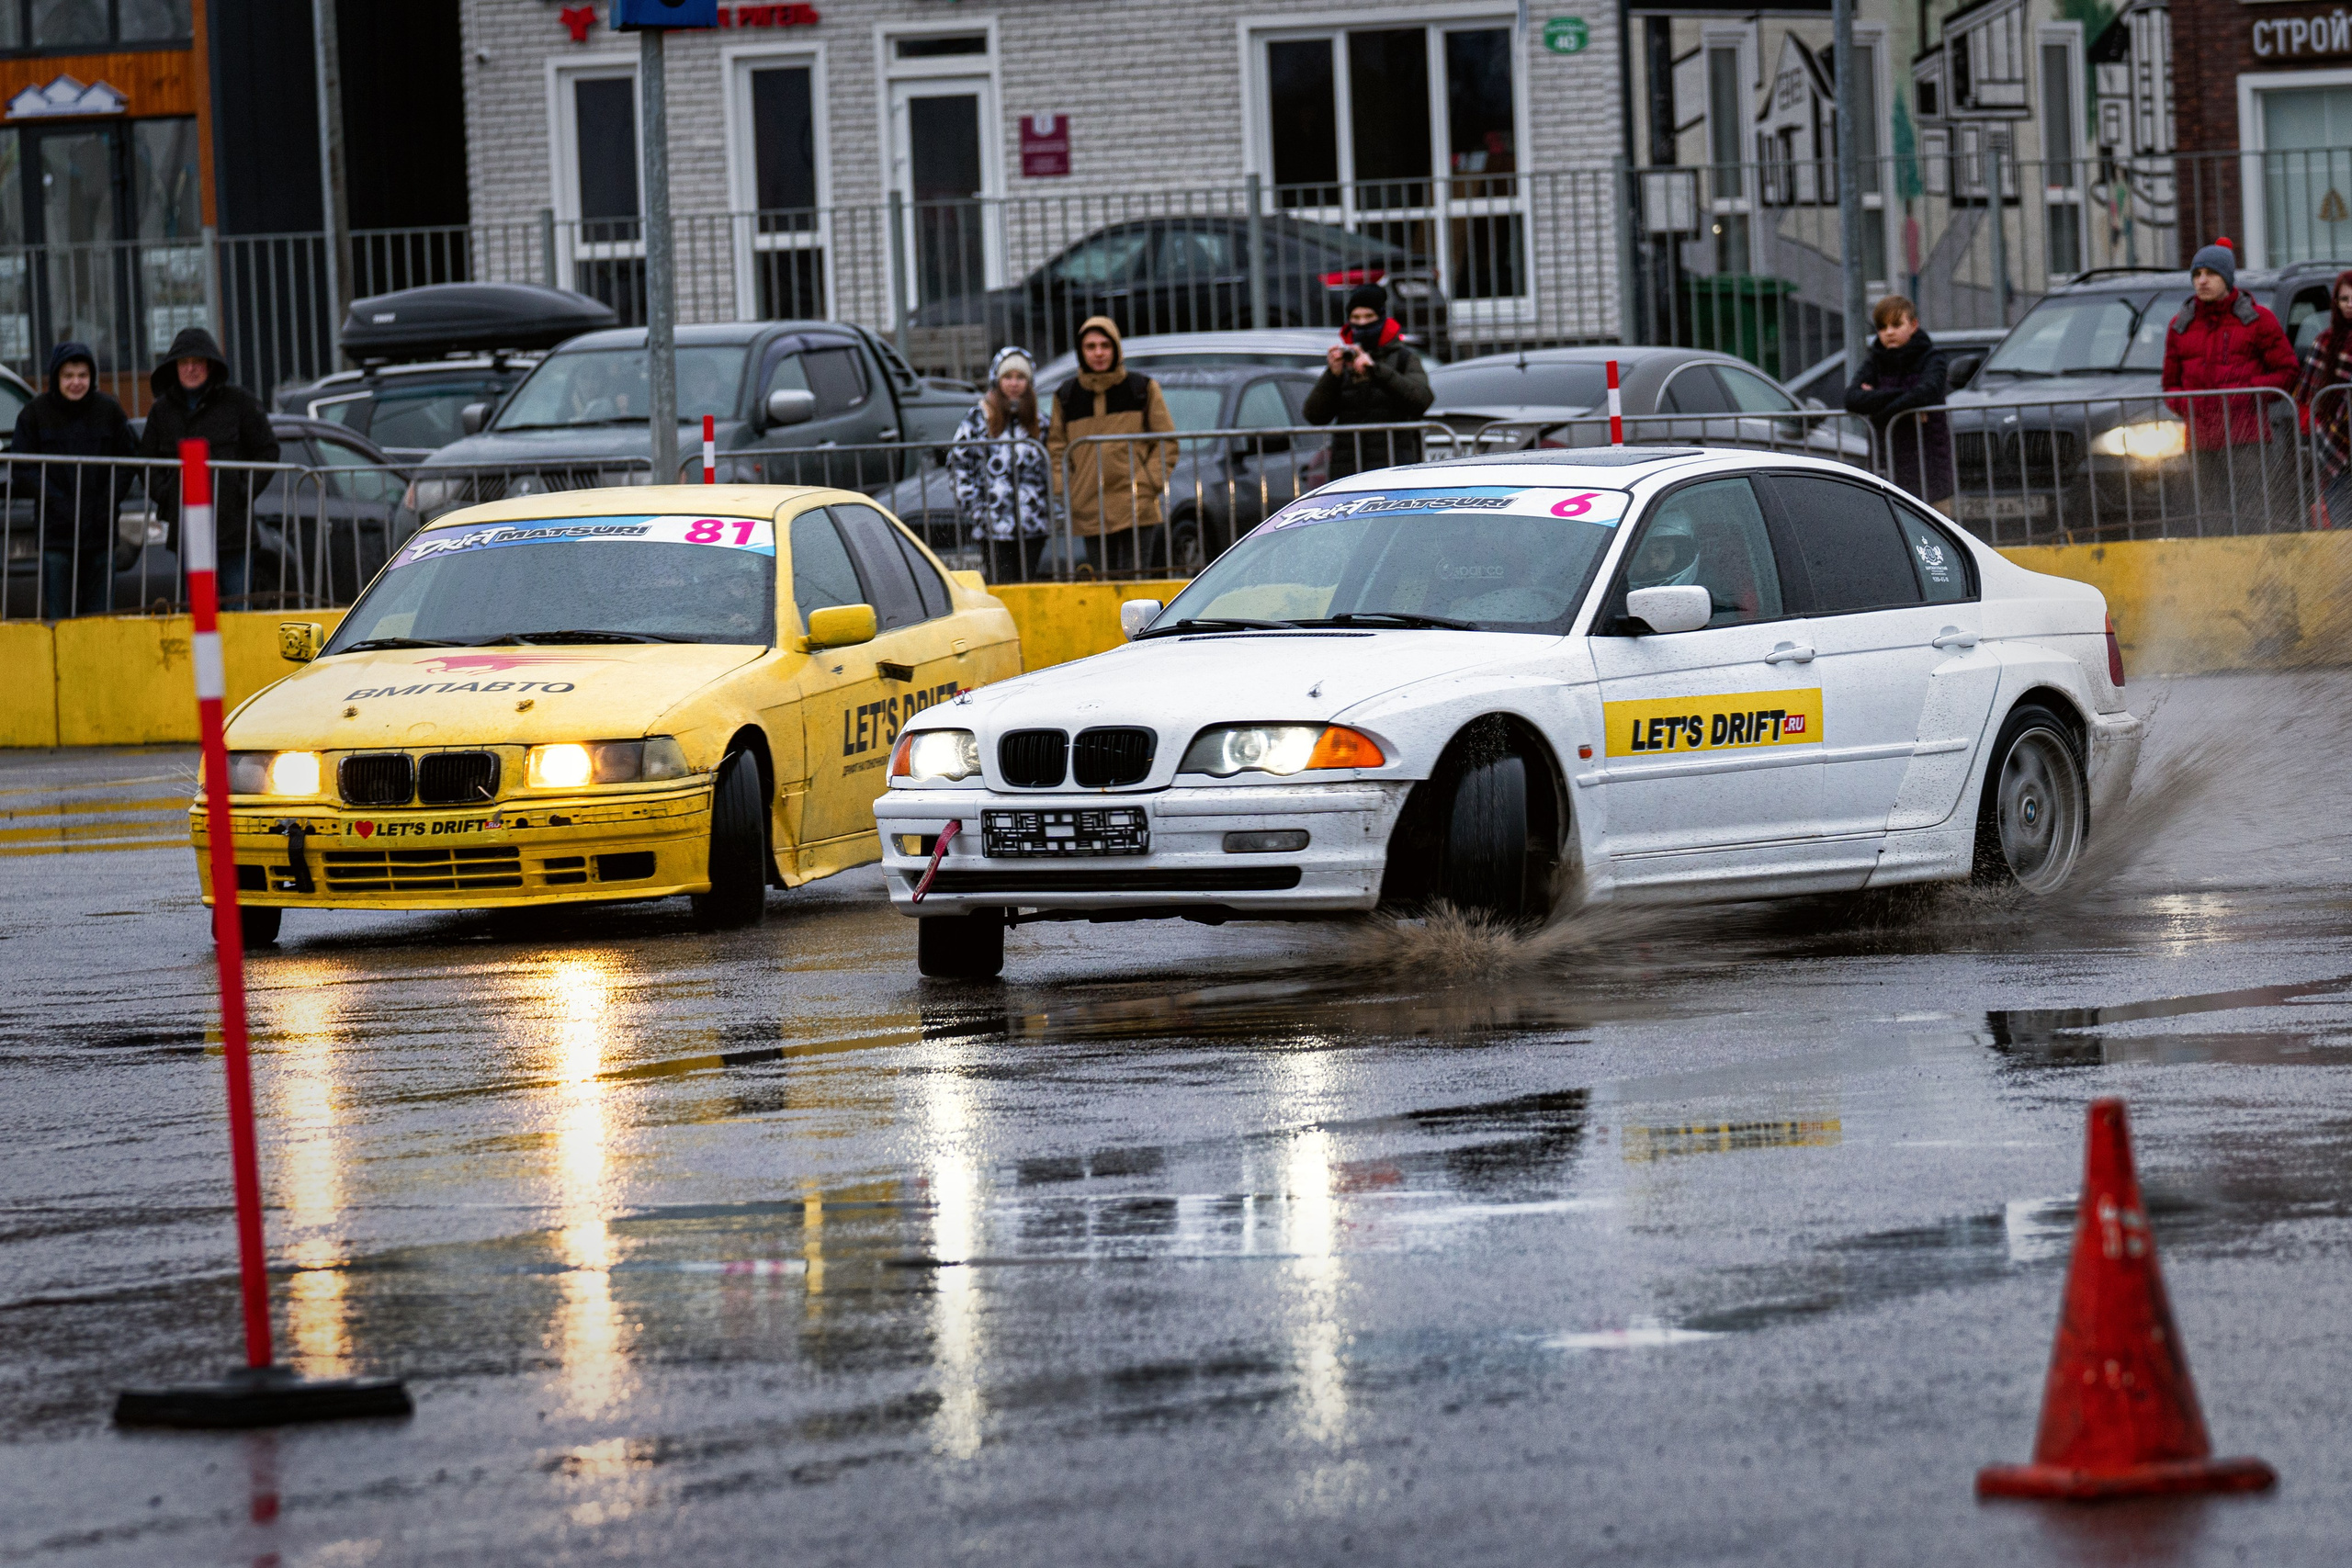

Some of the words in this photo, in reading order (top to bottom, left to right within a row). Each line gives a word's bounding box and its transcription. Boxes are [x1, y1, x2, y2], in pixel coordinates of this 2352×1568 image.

[2253, 7, 2352, 56] СТРОЙ
[1357, 496, 1520, 514] MATSURI
[1550, 492, 1603, 517] 6
[493, 525, 653, 543] MATSURI
[684, 519, 756, 546] 81
[343, 682, 576, 702] ВМПАВТО
[842, 696, 899, 757] LET'S
[1631, 715, 1705, 752] LET'S
[345, 822, 353, 836] I
[376, 822, 426, 837] LET'S
